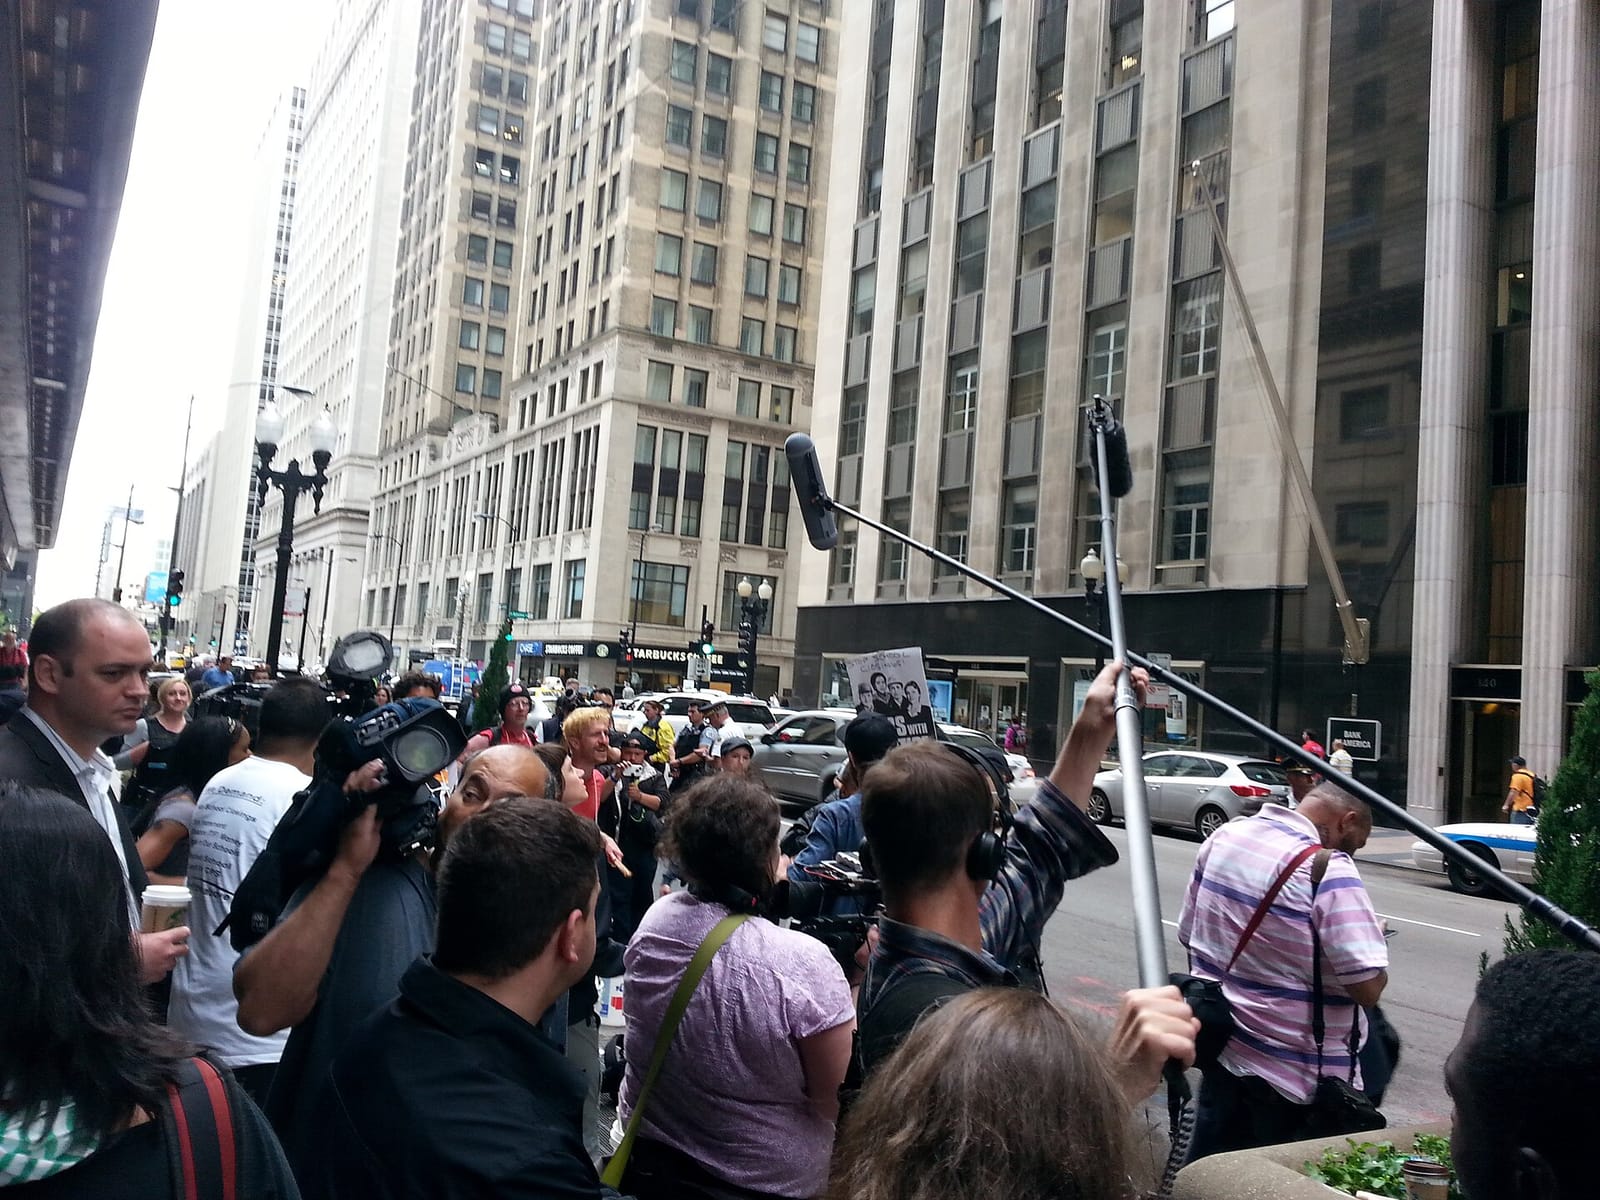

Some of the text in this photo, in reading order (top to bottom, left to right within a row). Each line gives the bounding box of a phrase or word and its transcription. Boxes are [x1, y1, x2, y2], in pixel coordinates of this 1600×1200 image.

[633, 648, 687, 662] TARBUCKS
[687, 652, 724, 665] CFEE
[907, 722, 929, 735] WITH
[1344, 730, 1362, 739] BANK
[1343, 739, 1372, 749] AMERICA
